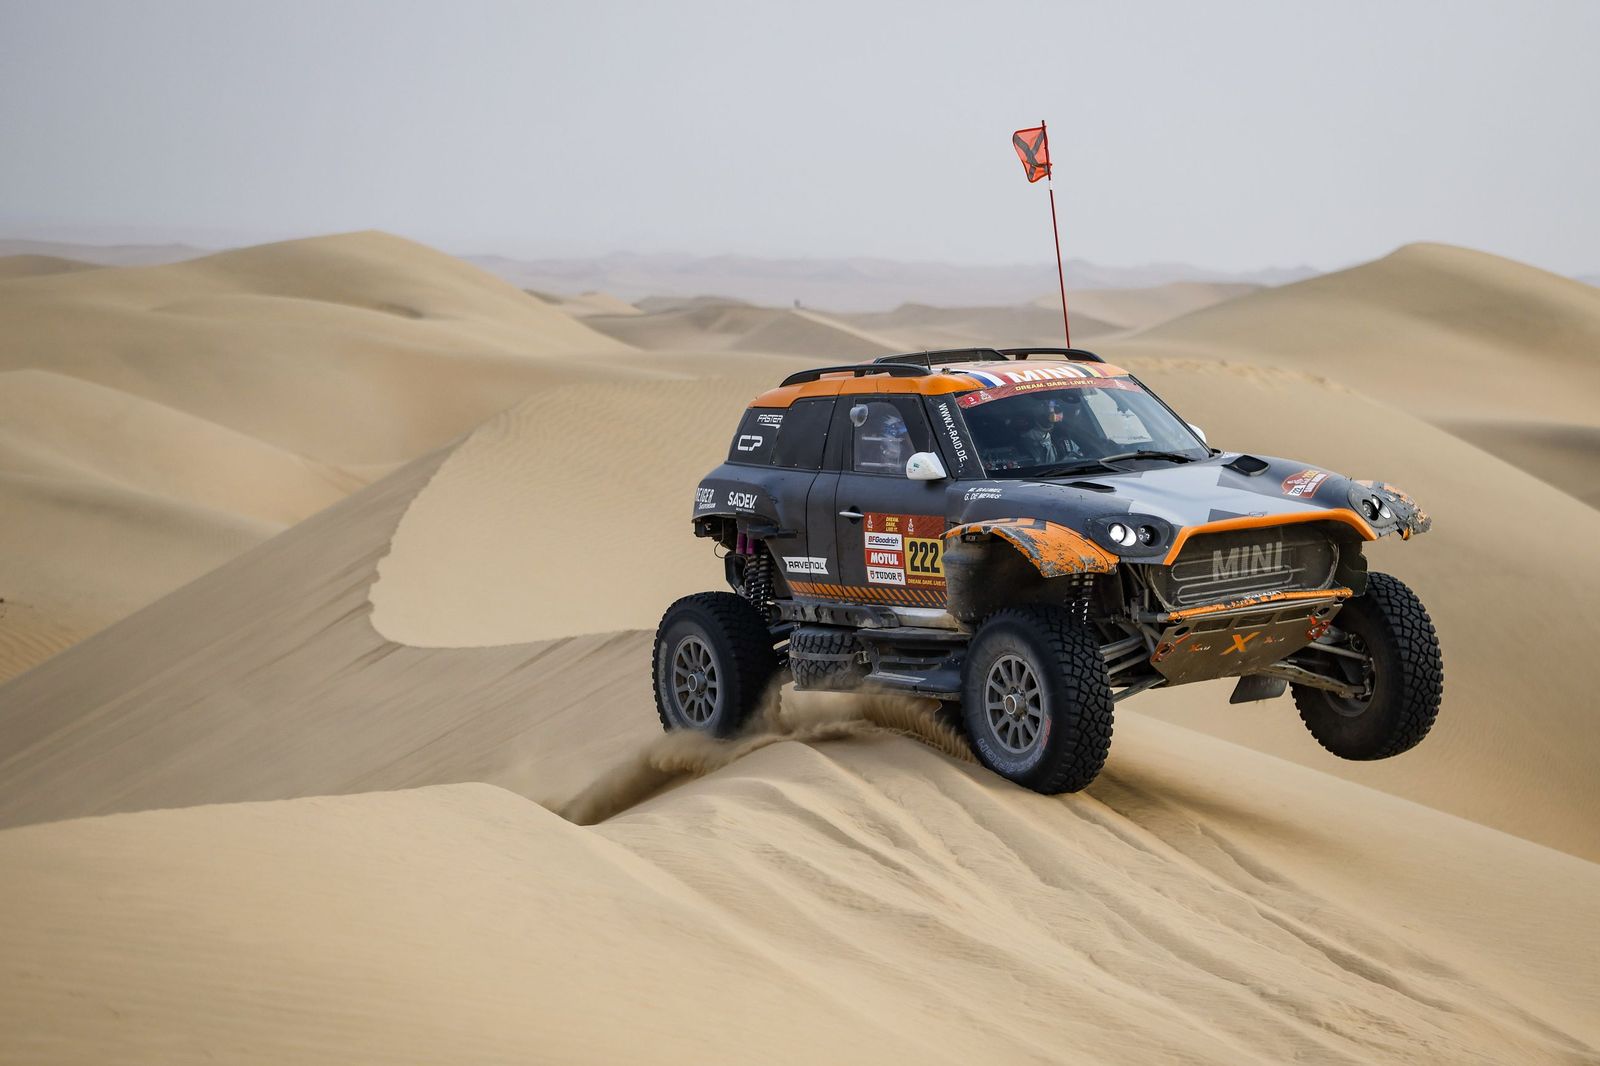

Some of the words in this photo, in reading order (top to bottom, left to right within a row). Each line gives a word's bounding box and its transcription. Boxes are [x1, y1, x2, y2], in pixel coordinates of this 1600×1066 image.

[1005, 366, 1087, 383] MINI
[1015, 383, 1046, 391] DREAM.
[757, 414, 783, 423] FASTER
[737, 435, 763, 451] CP
[868, 535, 899, 544] BFGoodrich
[870, 552, 899, 565] MOTUL
[909, 541, 941, 573] 222
[1213, 541, 1283, 582] MINI
[788, 561, 824, 570] RAVENOL
[875, 571, 898, 580] TUDOR
